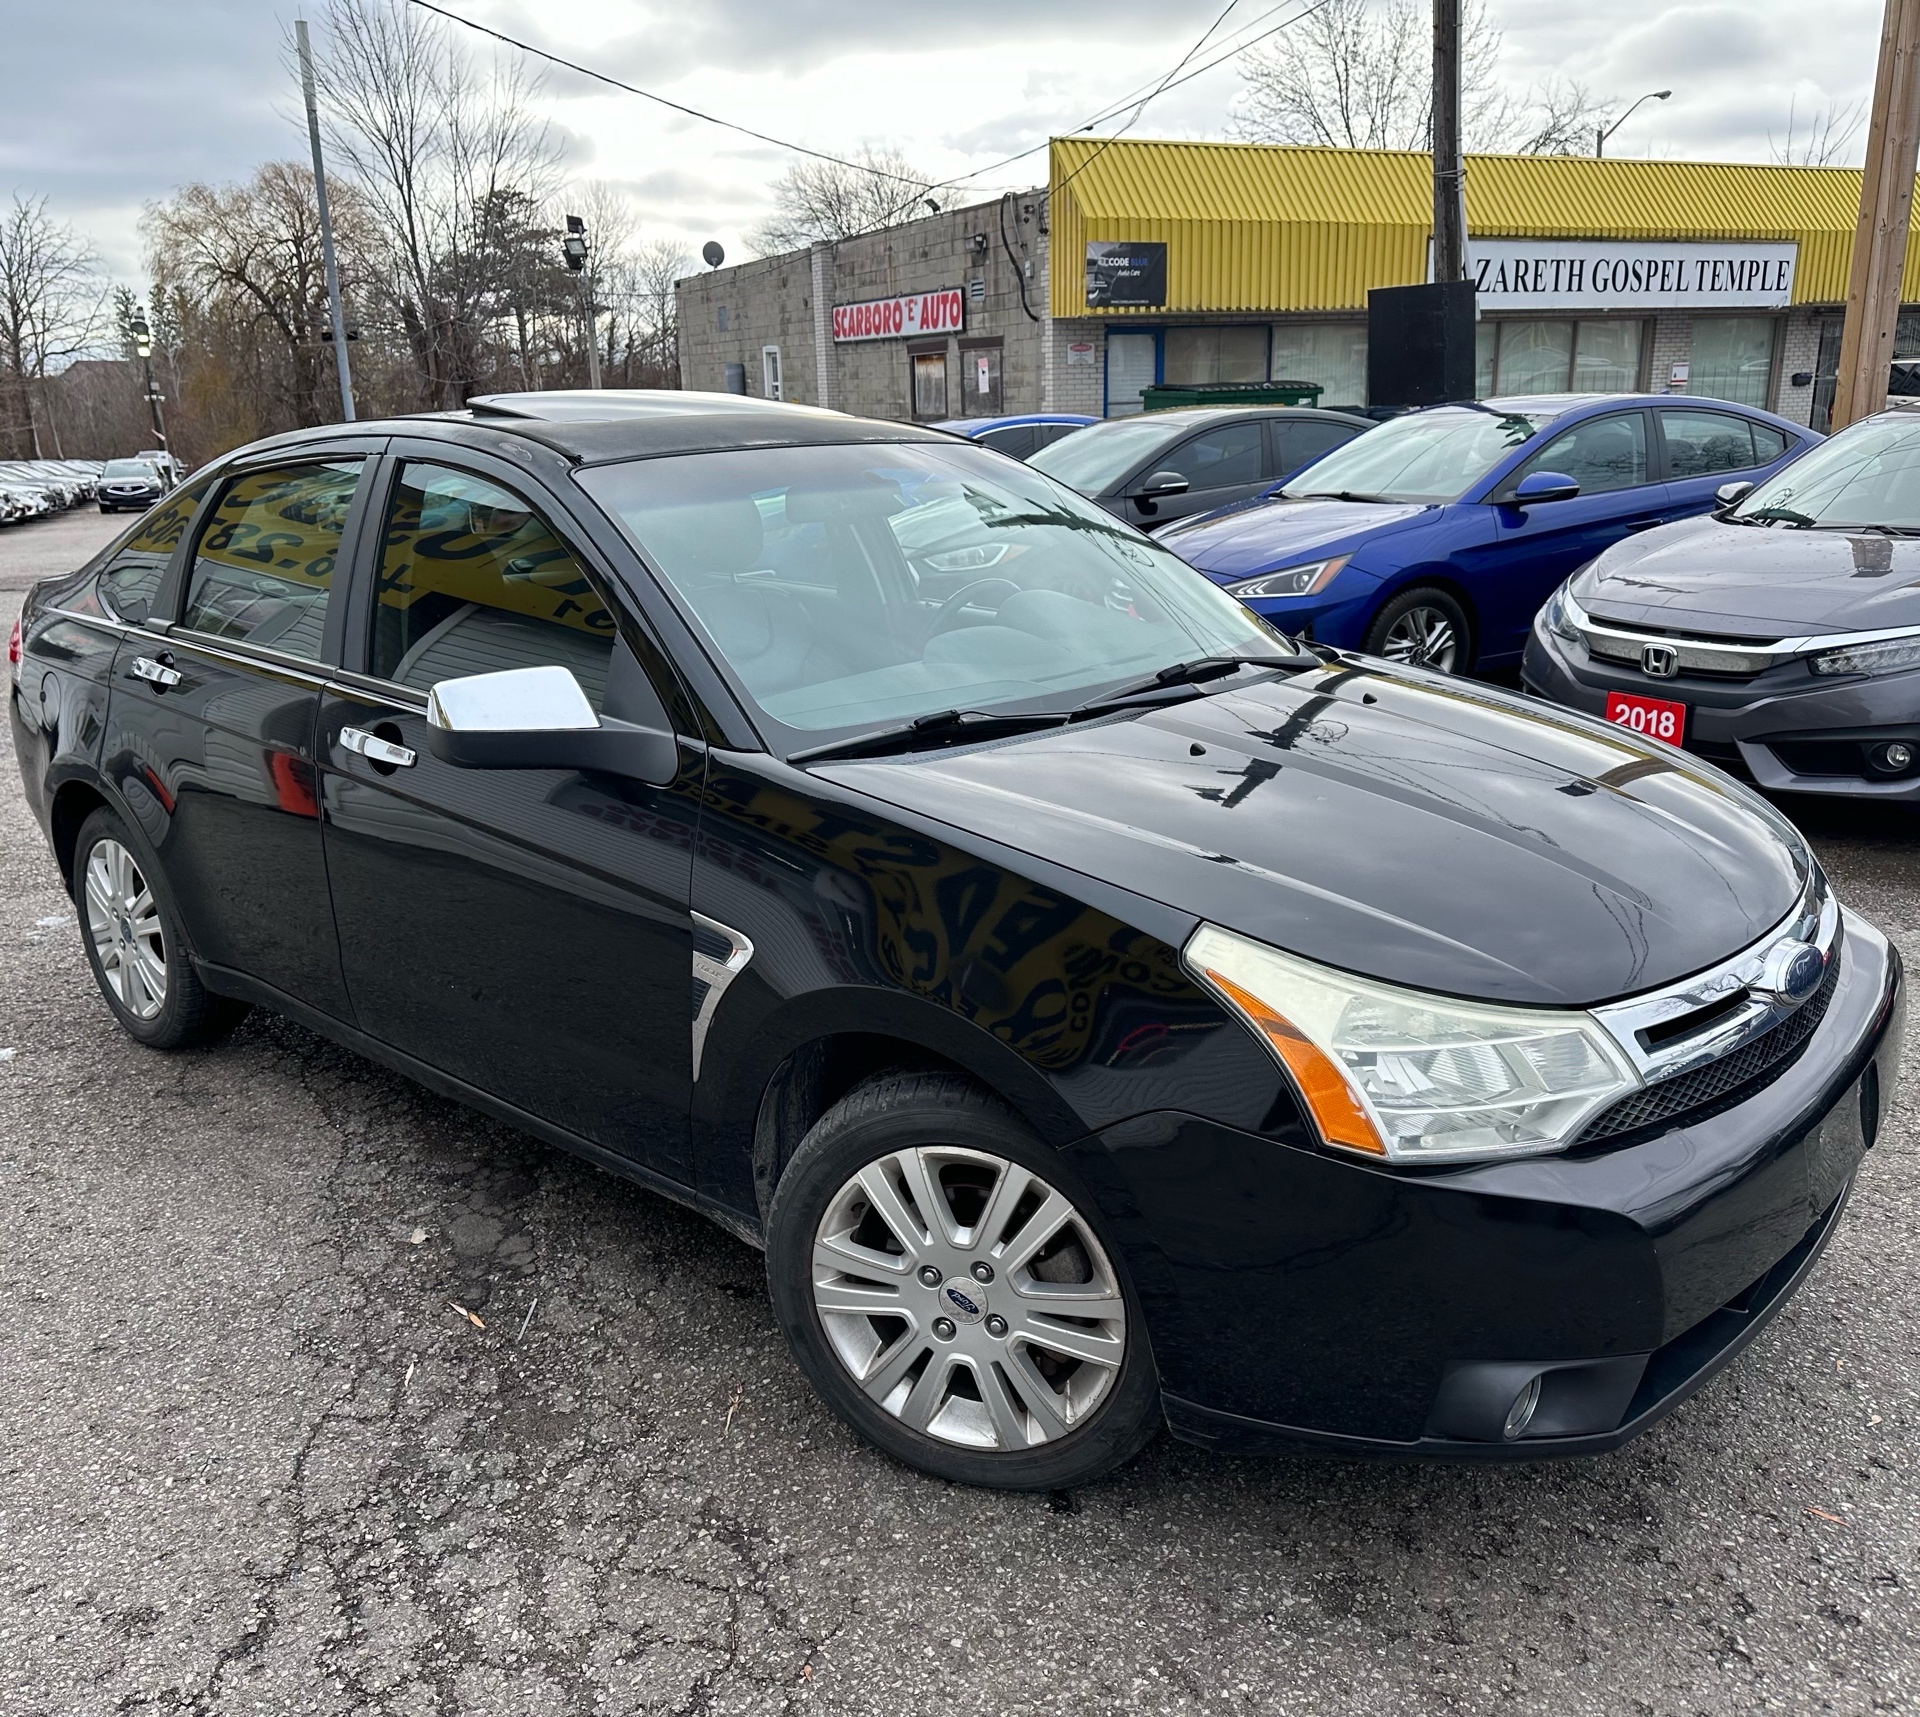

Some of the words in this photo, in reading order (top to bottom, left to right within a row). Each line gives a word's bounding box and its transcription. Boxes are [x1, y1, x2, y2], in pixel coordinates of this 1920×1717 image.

[1108, 257, 1129, 267] CODE
[1461, 258, 1586, 293] ZARETH
[1592, 258, 1690, 293] GOSPEL
[1696, 259, 1790, 292] TEMPLE
[834, 300, 903, 339] SCARBORO
[920, 291, 961, 331] AUTO
[1614, 703, 1676, 738] 2018
[950, 1291, 976, 1312] Ford
